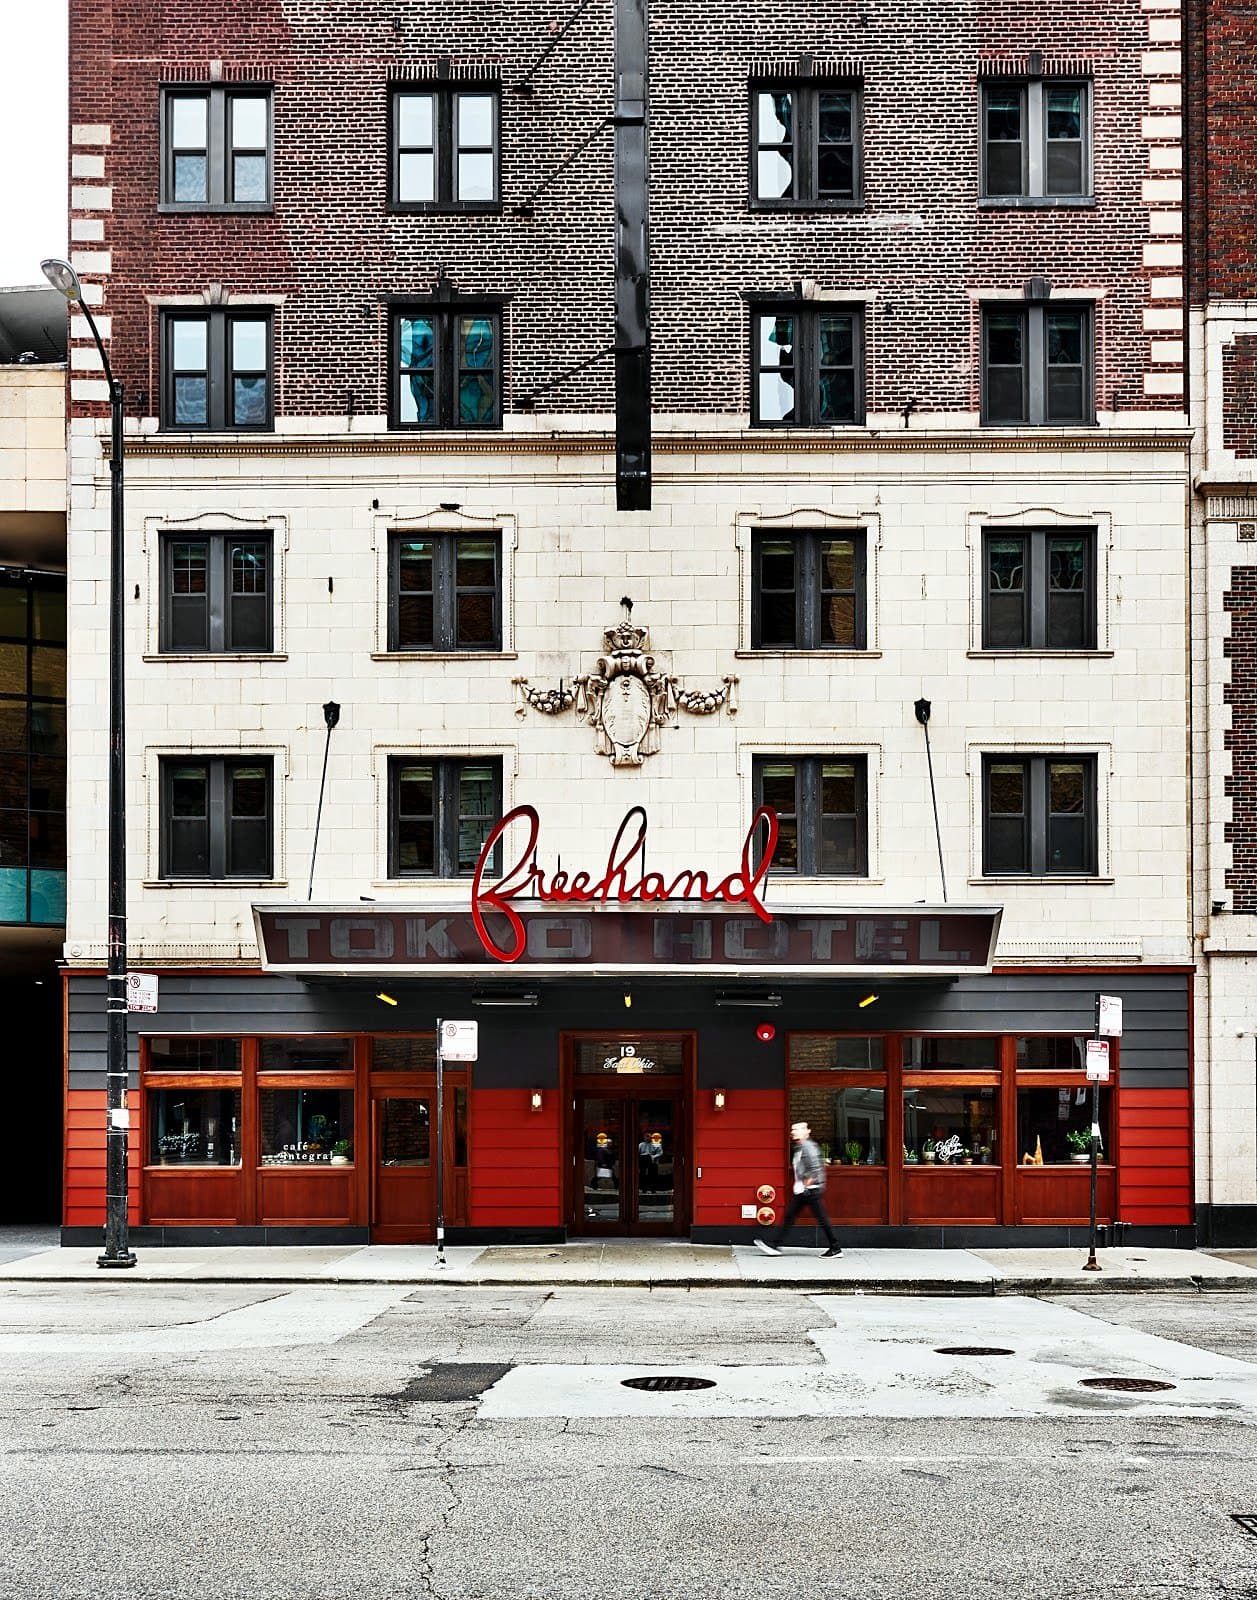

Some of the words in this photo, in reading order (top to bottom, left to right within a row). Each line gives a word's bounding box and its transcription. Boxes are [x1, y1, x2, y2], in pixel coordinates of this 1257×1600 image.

[472, 805, 779, 963] freehand
[620, 1045, 636, 1057] 19
[283, 1141, 309, 1151] café
